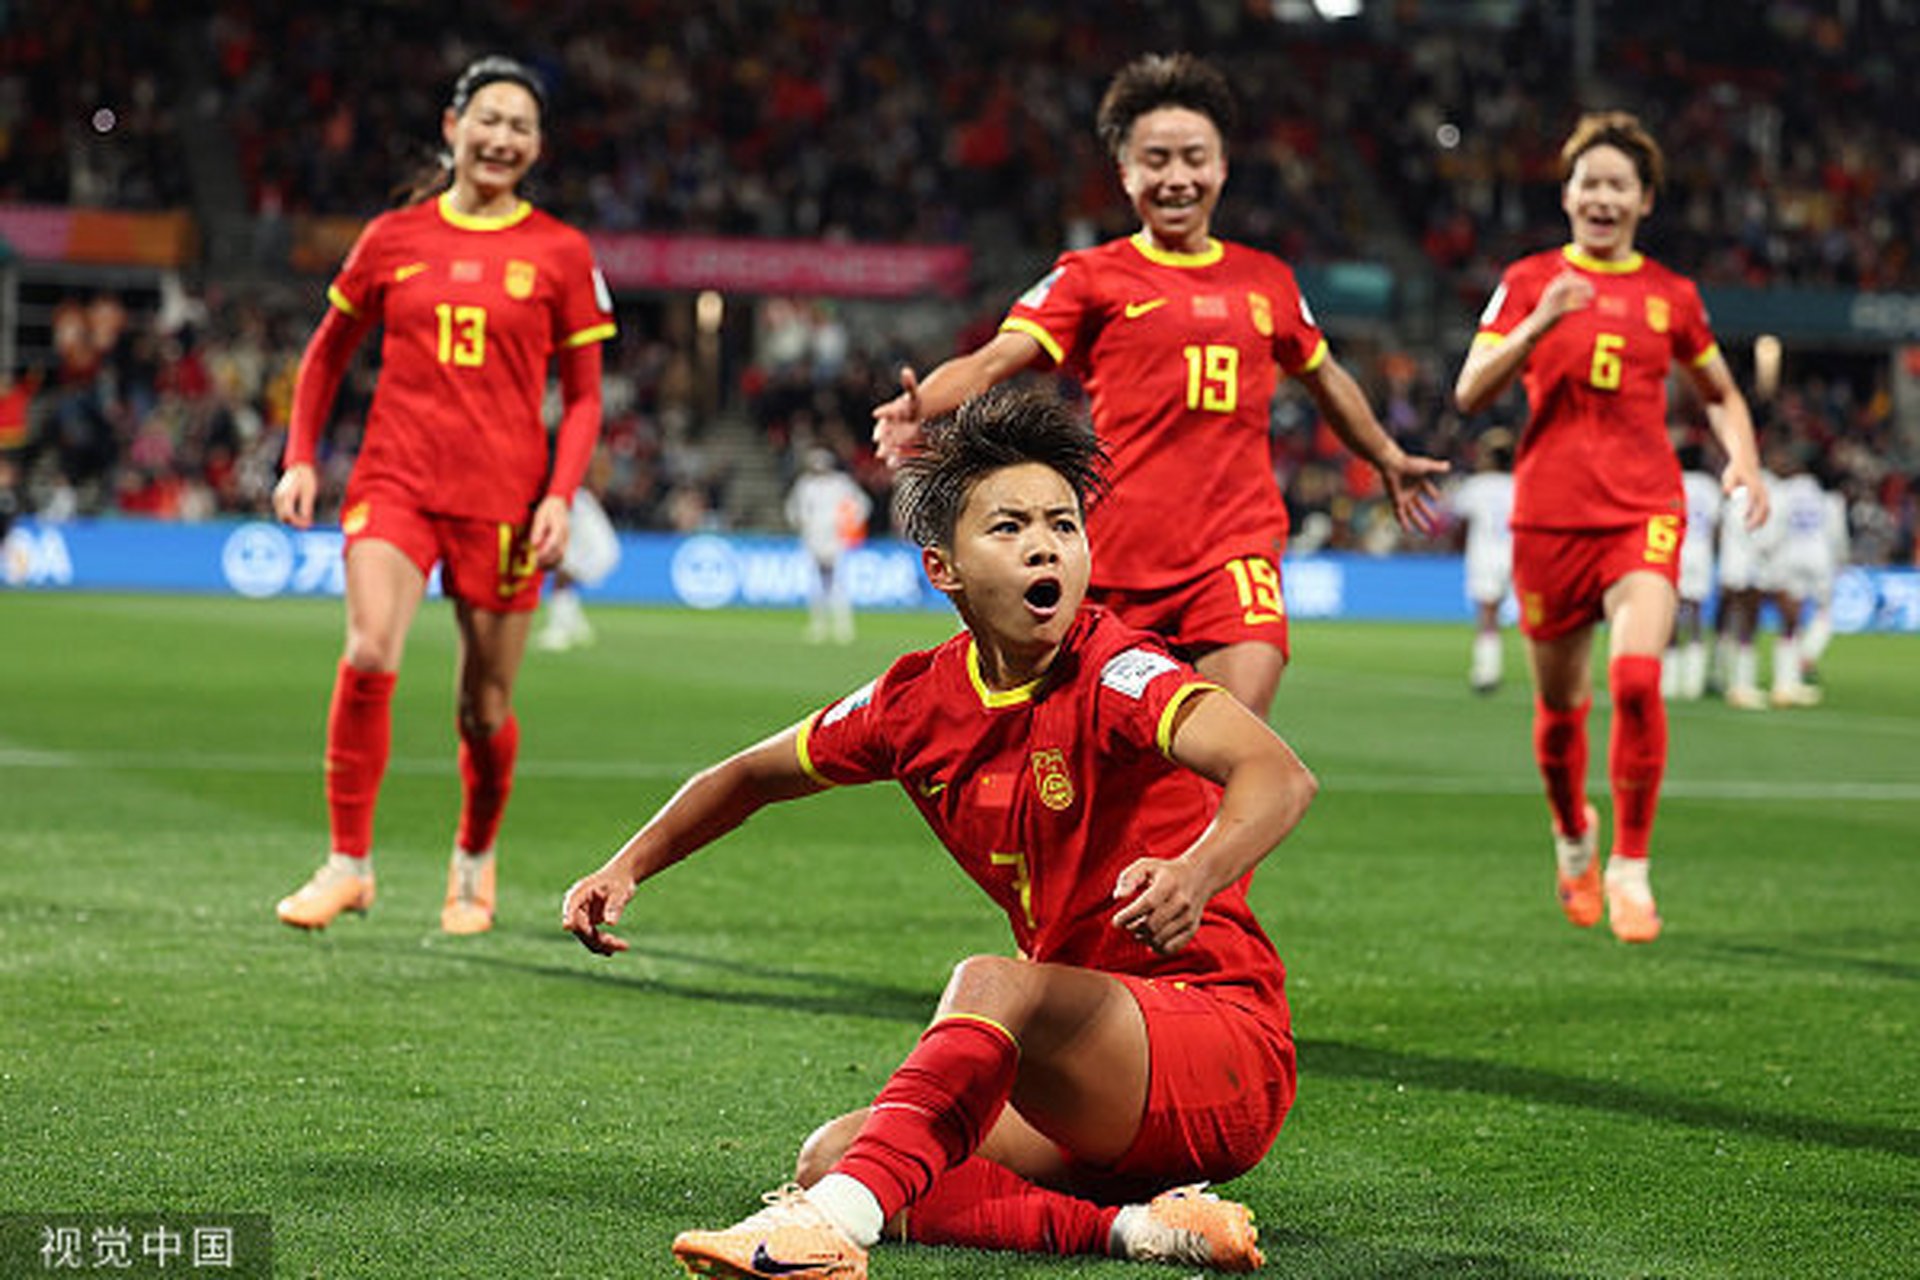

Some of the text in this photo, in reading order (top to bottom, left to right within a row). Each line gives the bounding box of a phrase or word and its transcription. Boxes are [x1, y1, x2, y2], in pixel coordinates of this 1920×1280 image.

[435, 303, 487, 367] 13
[1591, 333, 1626, 389] 6
[1184, 345, 1239, 412] 19
[1224, 557, 1284, 615] 19
[991, 852, 1037, 929] 7
